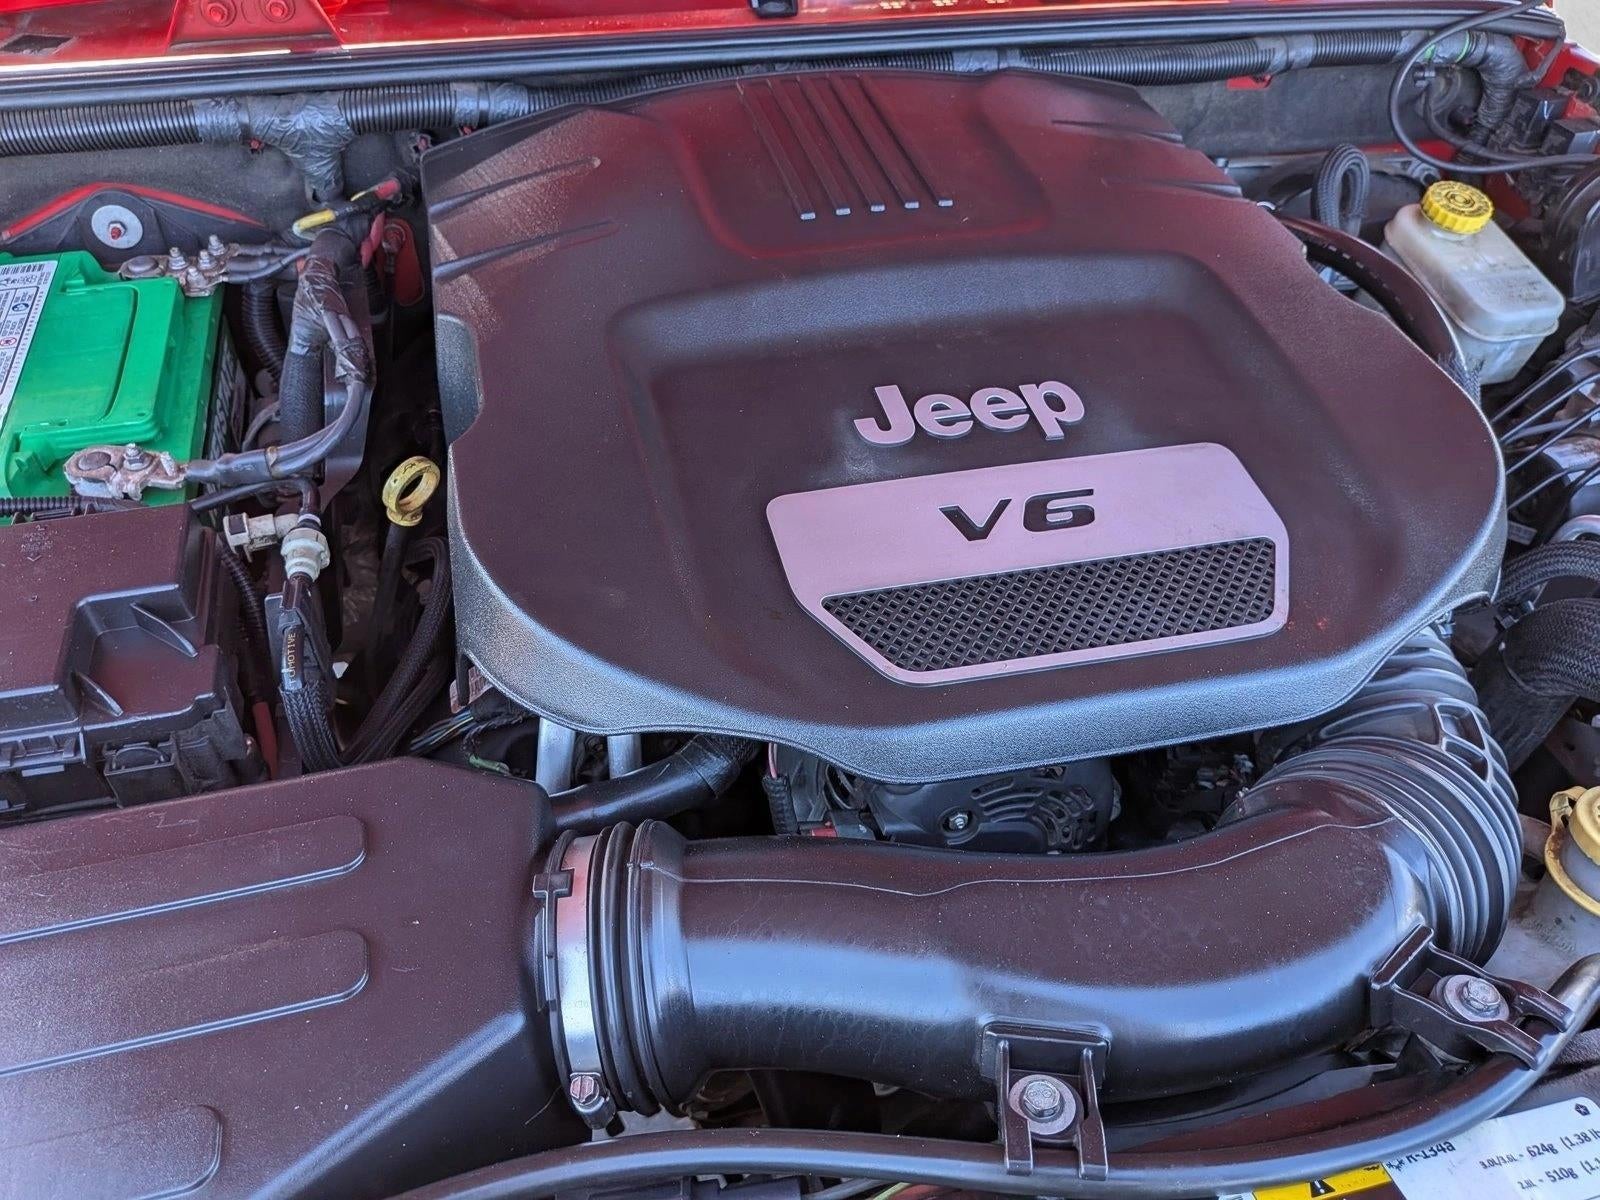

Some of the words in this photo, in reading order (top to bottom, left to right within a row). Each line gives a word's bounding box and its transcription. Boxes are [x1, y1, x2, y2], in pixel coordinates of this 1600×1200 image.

[853, 380, 1086, 446] Jeep
[937, 488, 1097, 542] V6
[1526, 1142, 1559, 1158] 624g
[1560, 1131, 1592, 1151] (1.38
[1544, 1166, 1579, 1183] 510g
